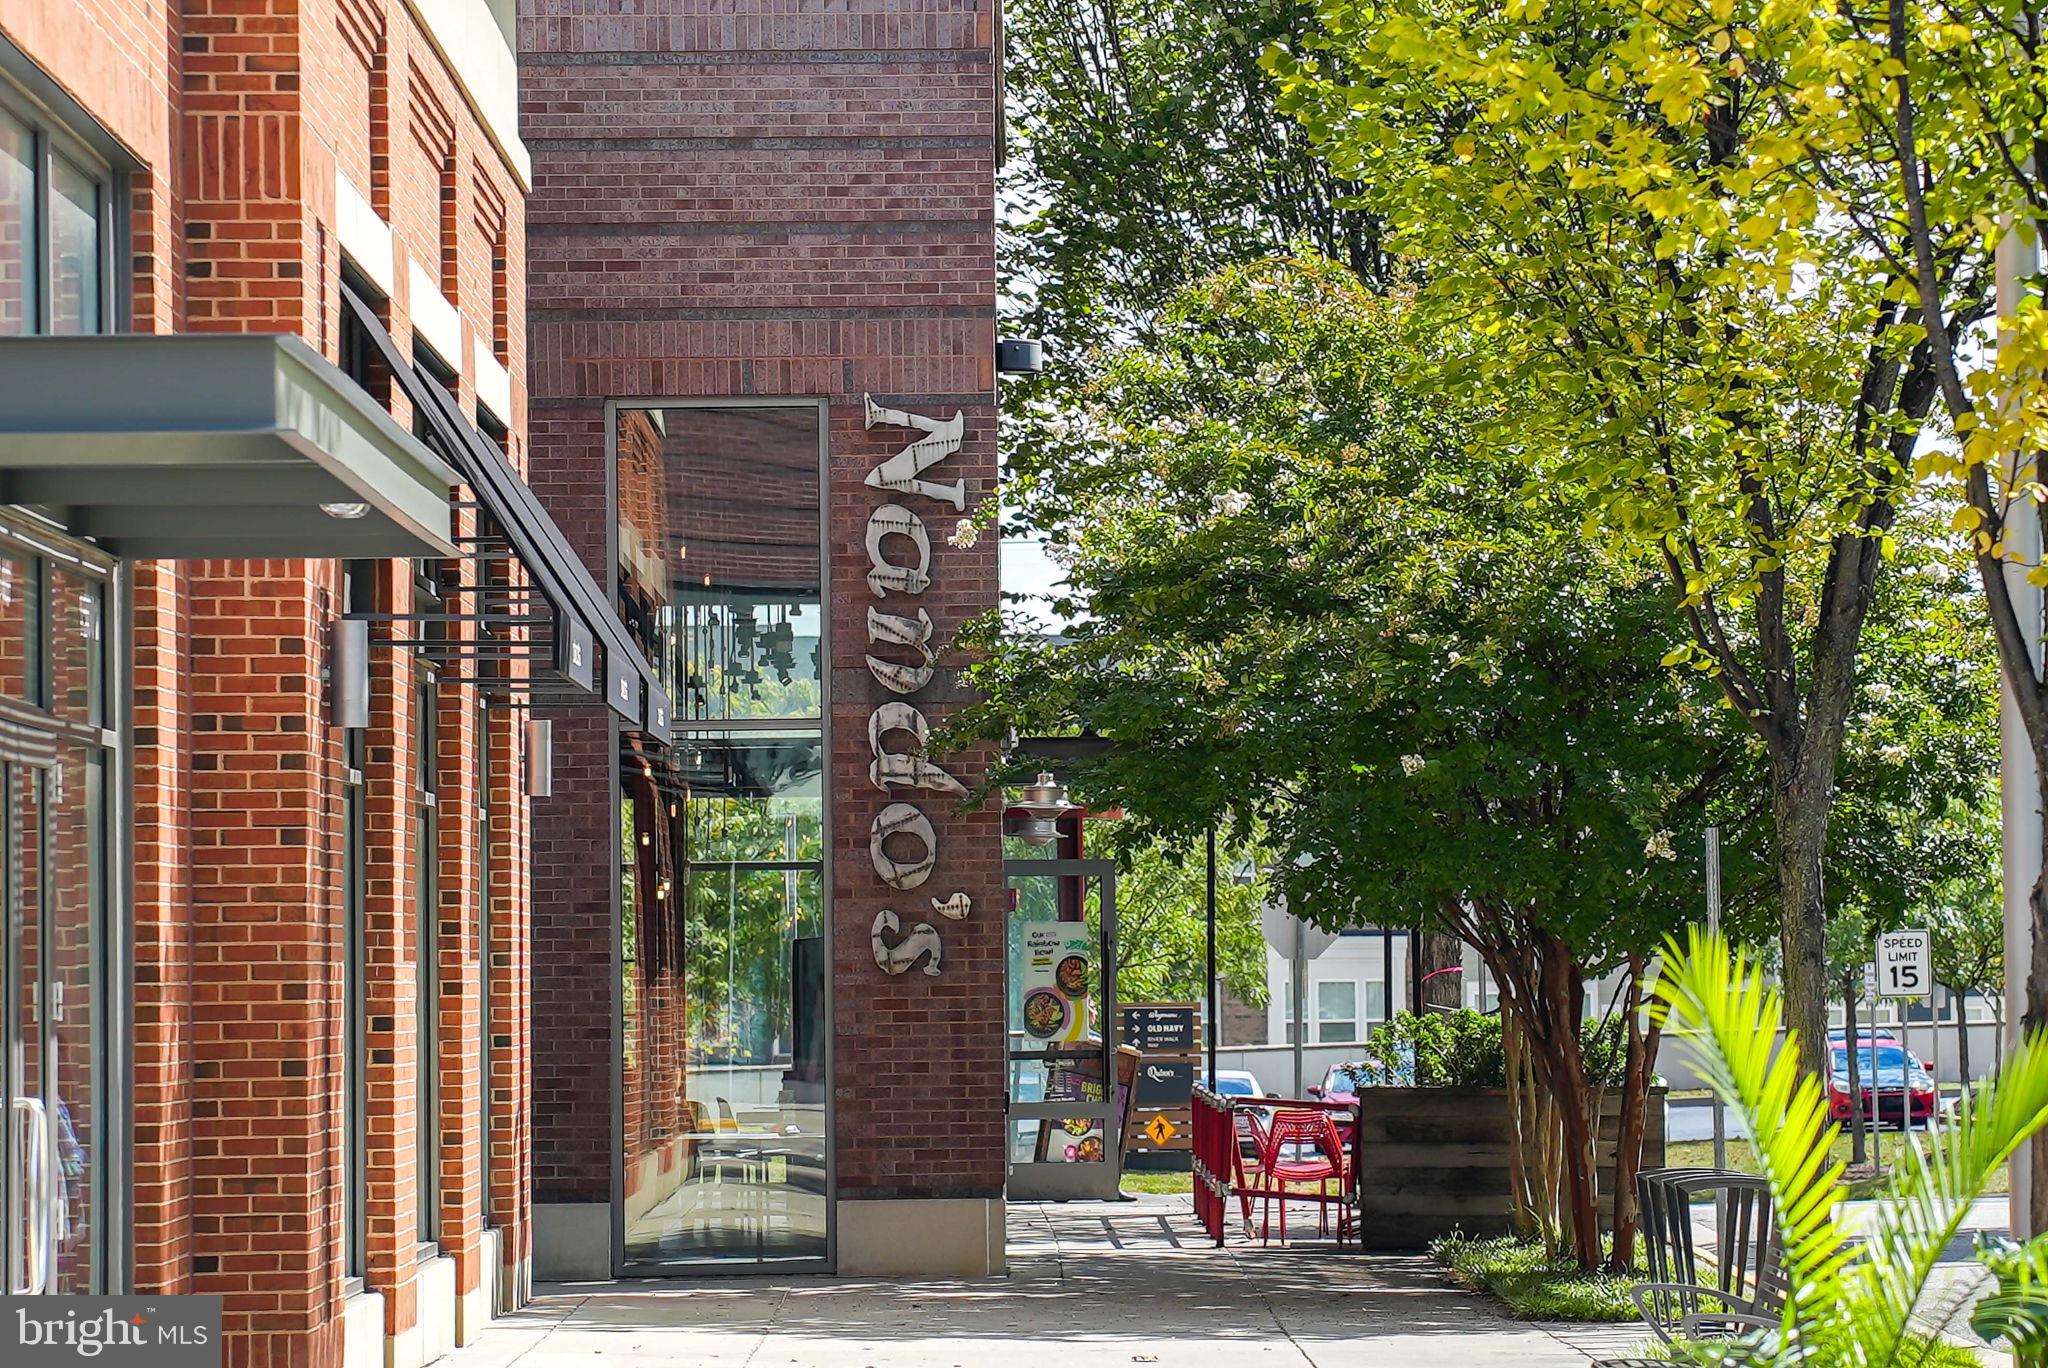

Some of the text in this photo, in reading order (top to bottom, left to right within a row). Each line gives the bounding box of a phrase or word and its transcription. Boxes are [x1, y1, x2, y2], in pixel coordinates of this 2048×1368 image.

[864, 391, 971, 976] Nando's
[1883, 938, 1923, 949] SPEED
[1888, 952, 1918, 962] LIMIT
[1890, 966, 1919, 988] 15
[1147, 1024, 1185, 1033] OLD NAVY
